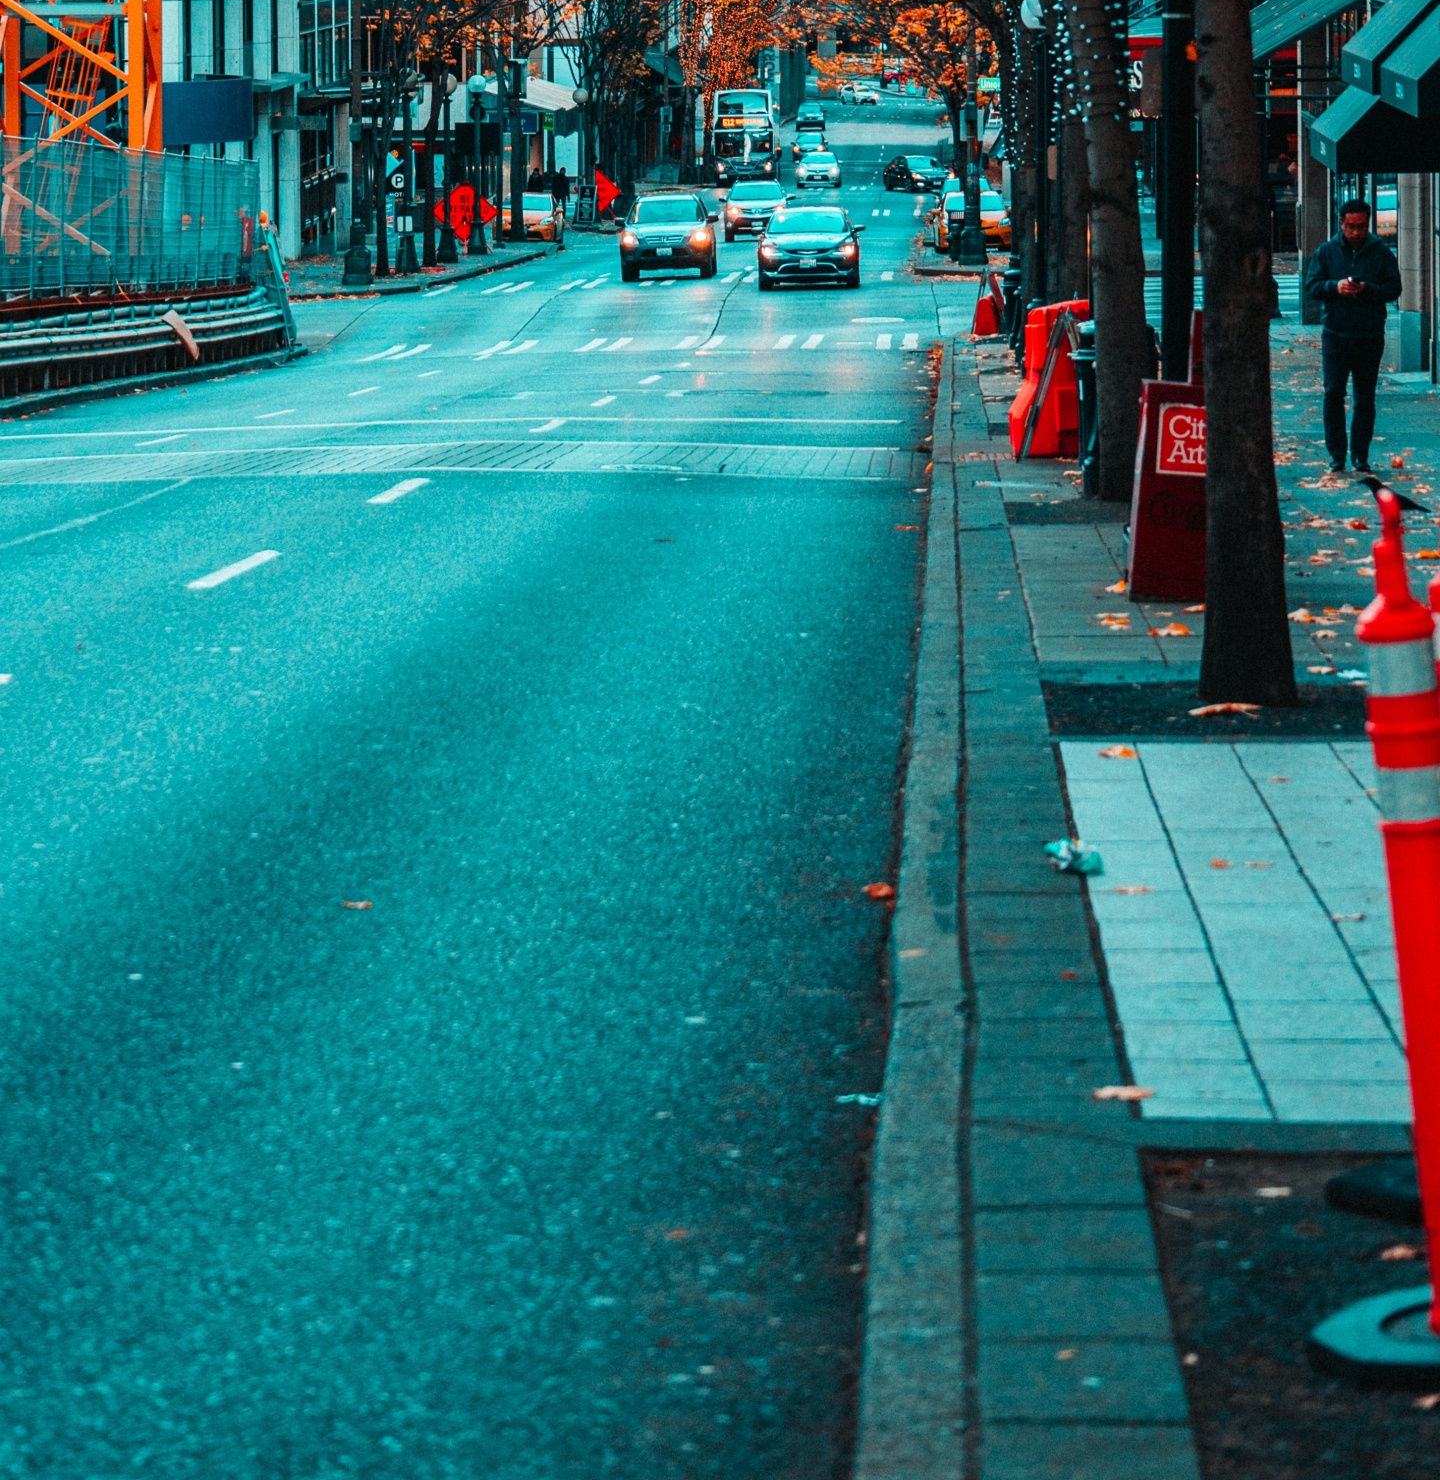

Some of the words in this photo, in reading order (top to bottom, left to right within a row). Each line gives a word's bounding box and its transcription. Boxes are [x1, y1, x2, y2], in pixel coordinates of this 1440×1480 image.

[460, 194, 471, 203] BE
[1168, 415, 1205, 440] Cit
[1166, 440, 1206, 465] Art
